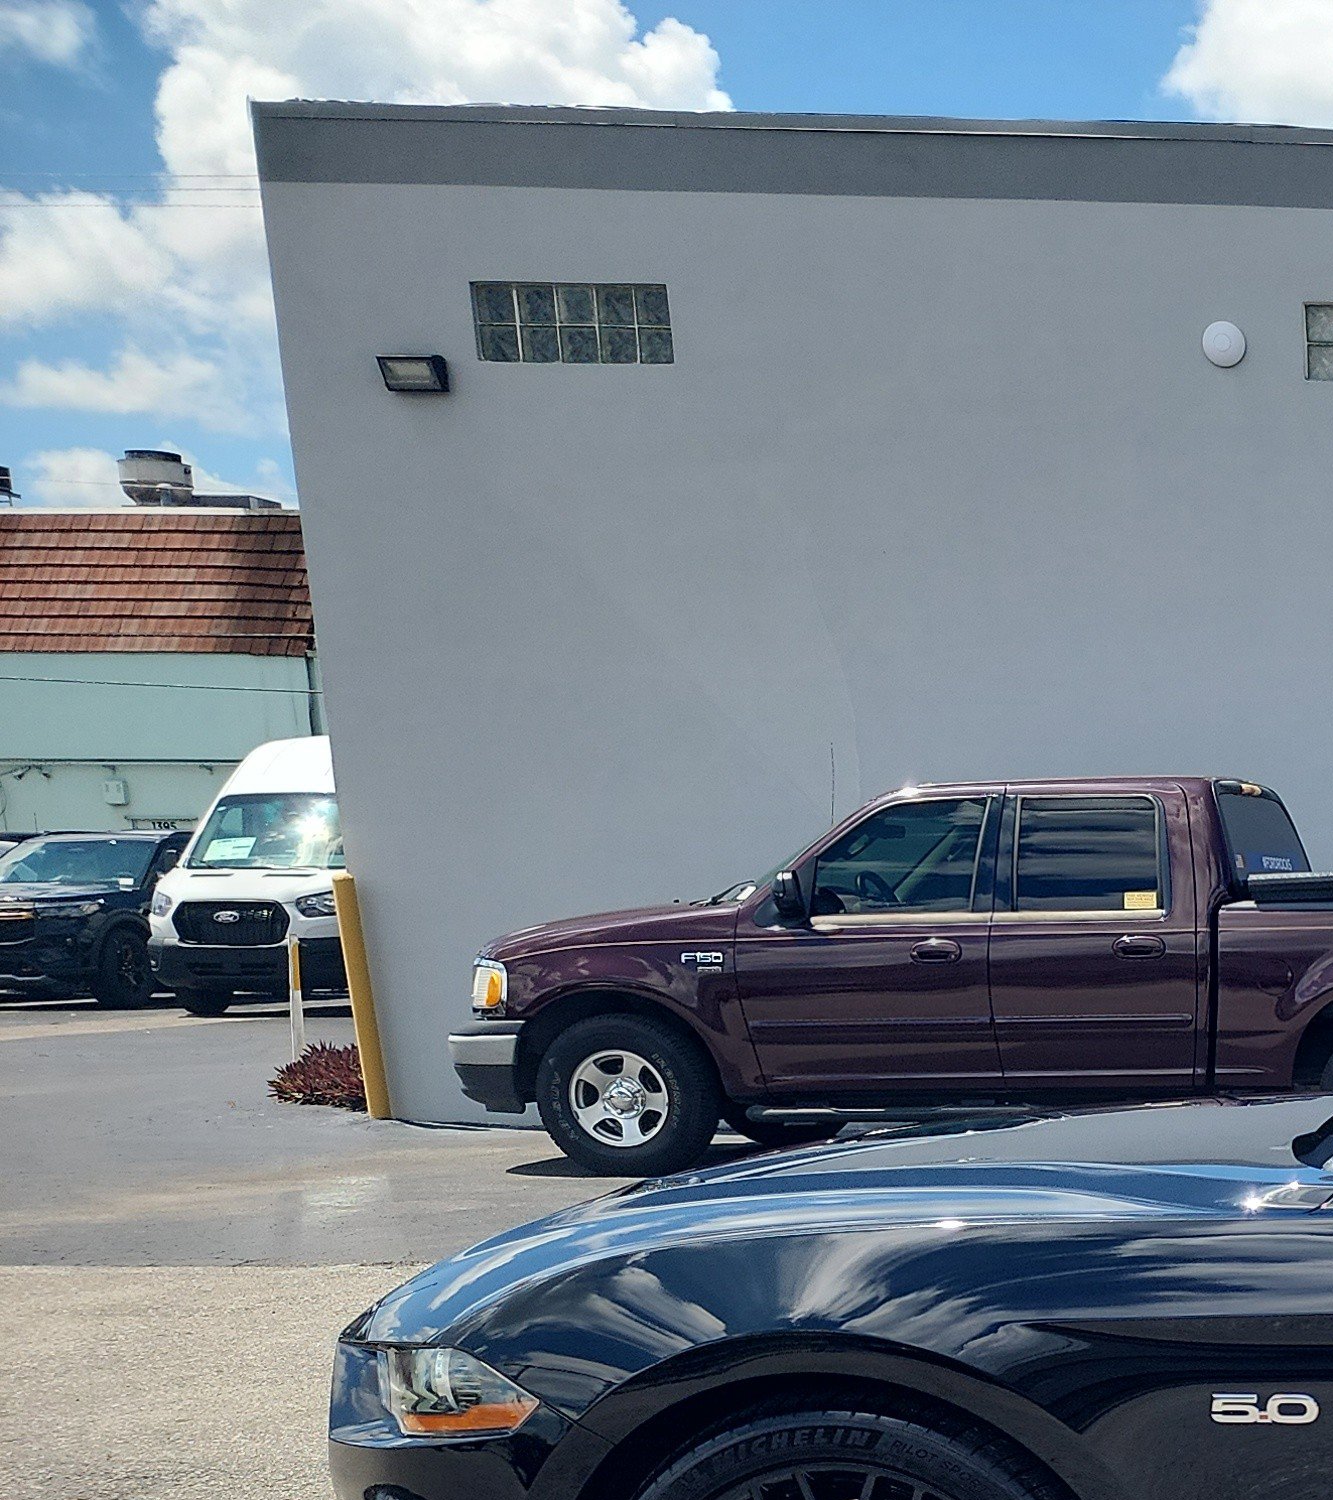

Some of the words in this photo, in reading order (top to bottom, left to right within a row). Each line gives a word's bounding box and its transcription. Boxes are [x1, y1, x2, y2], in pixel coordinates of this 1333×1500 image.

[151, 821, 178, 830] 1395
[1210, 1393, 1320, 1424] 5.0
[710, 1427, 872, 1474] MICHELIN
[890, 1439, 938, 1463] PILOT
